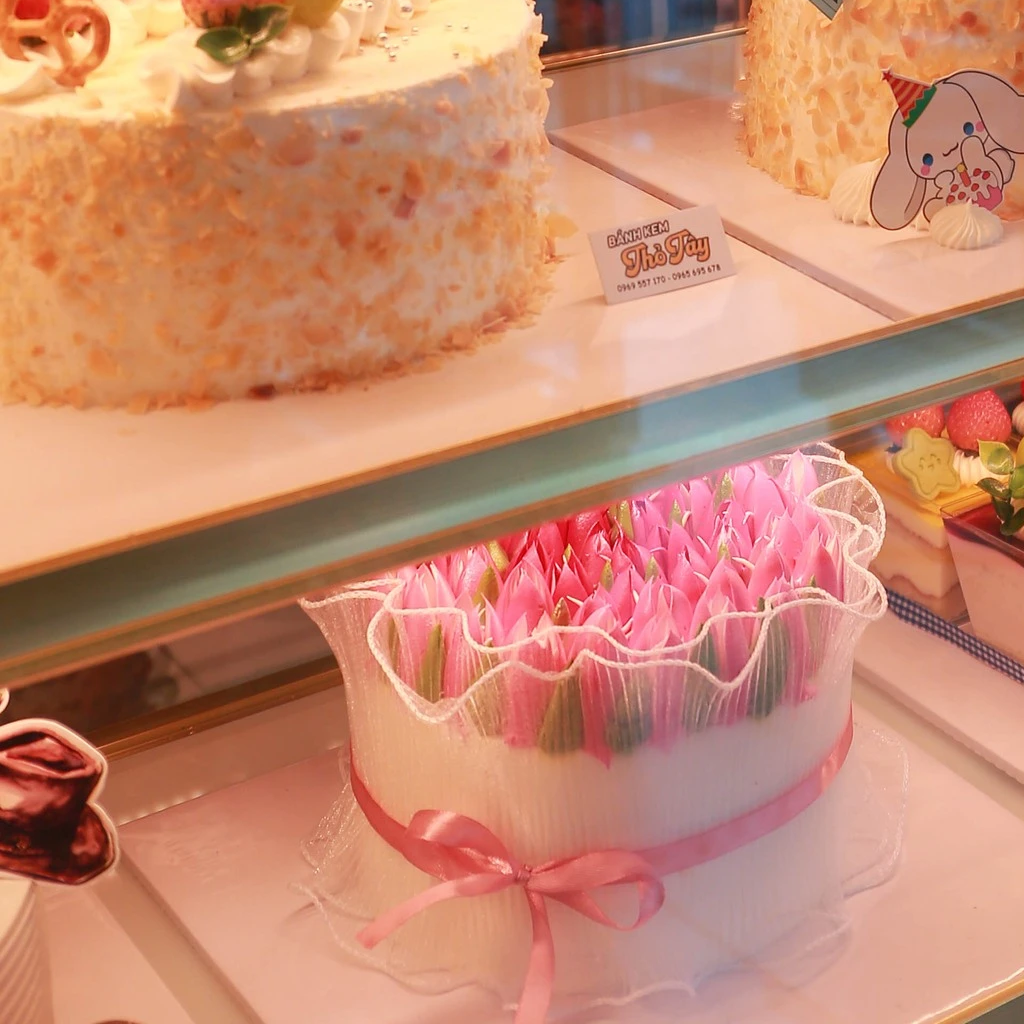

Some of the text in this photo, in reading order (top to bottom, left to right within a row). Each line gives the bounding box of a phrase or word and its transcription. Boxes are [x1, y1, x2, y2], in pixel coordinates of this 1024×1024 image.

[642, 220, 669, 237] KEM
[620, 229, 710, 278] Thỏ Tây
[617, 283, 636, 293] 0969
[637, 280, 651, 288] 557
[652, 276, 666, 284] 170
[672, 272, 691, 280] 0965
[707, 264, 721, 273] 678
